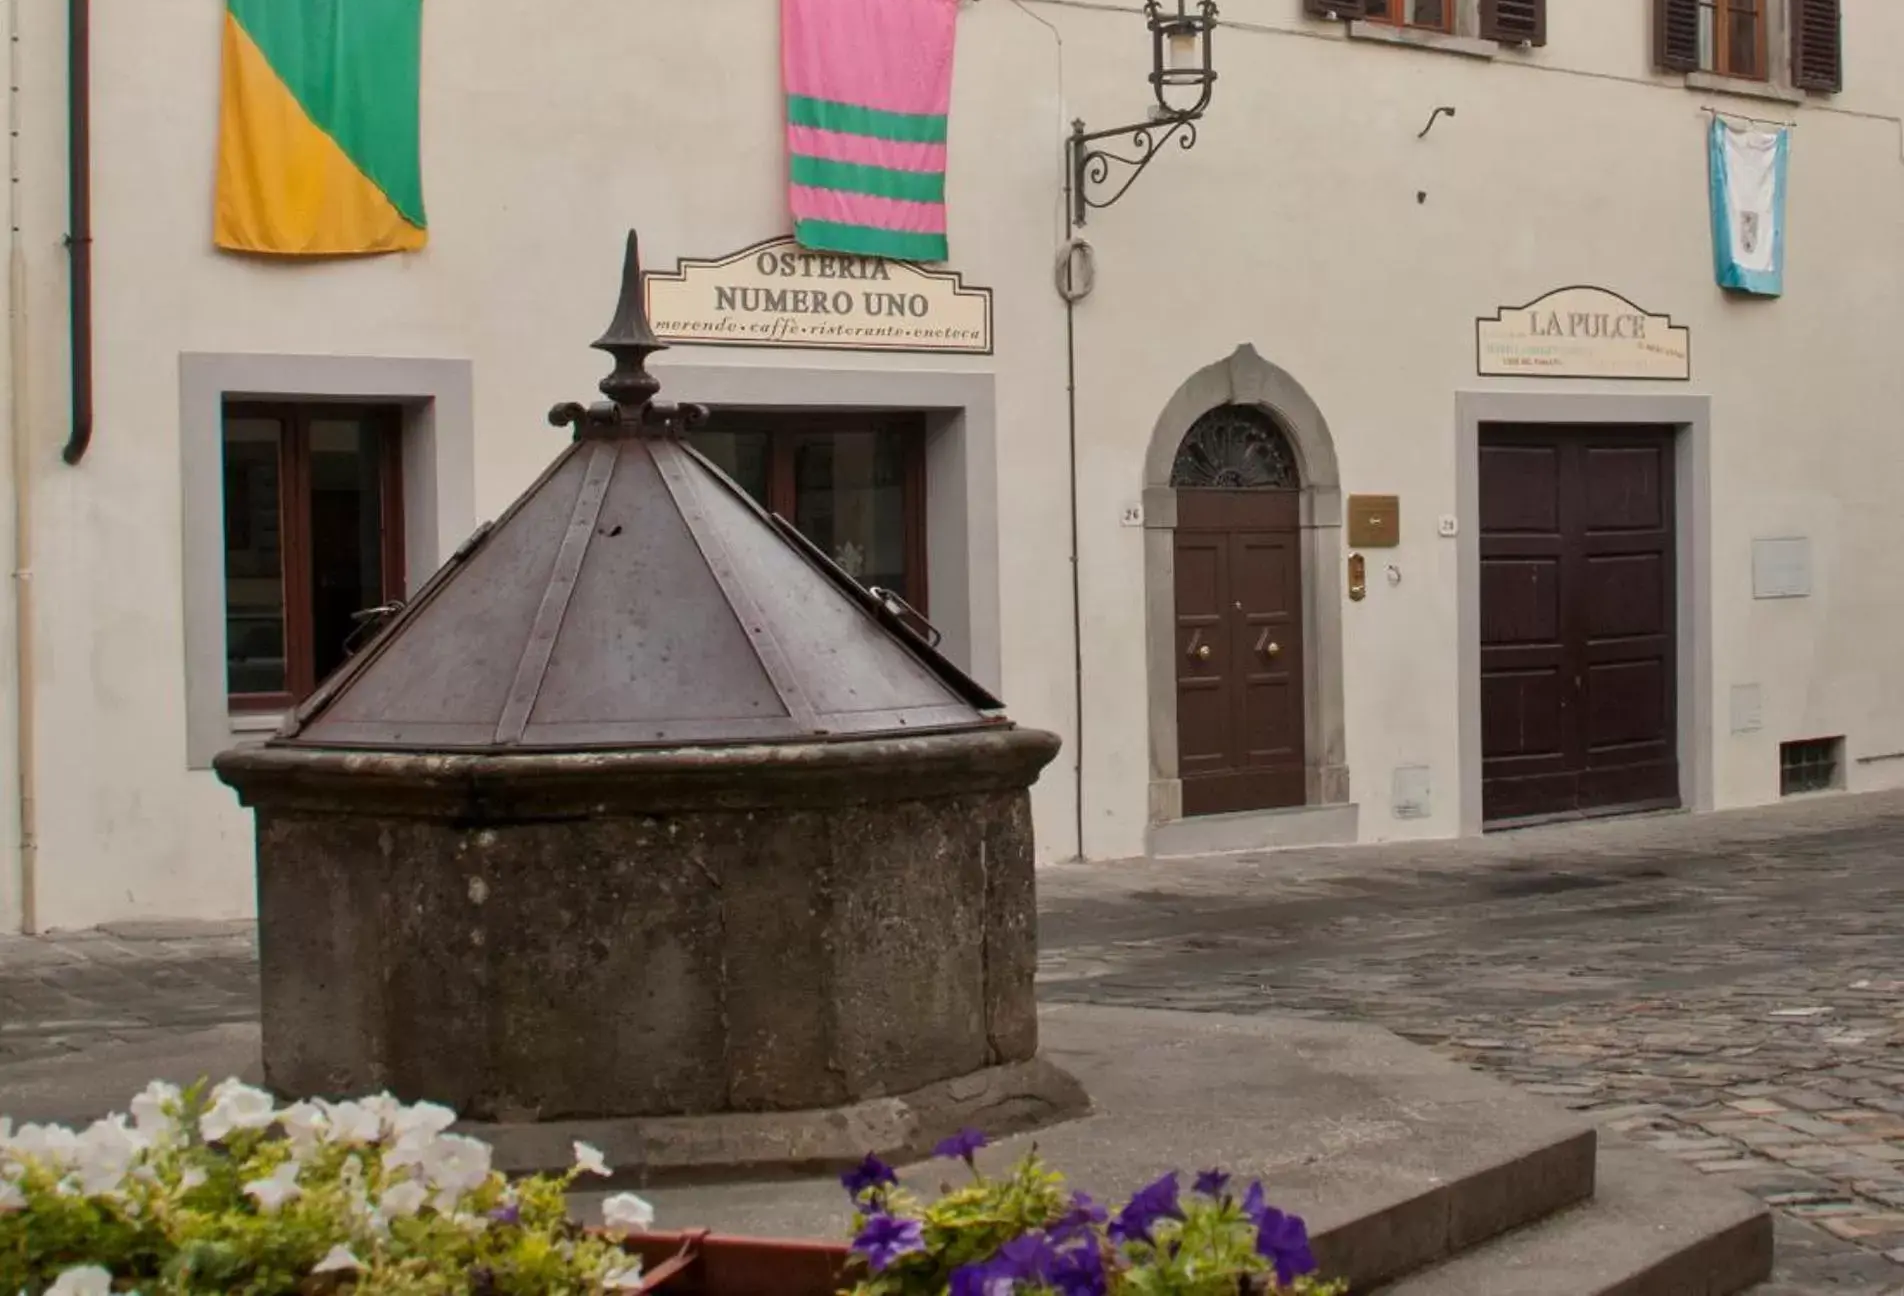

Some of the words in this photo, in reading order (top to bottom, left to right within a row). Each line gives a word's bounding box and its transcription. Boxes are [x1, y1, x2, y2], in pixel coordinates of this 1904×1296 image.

[756, 252, 891, 281] OSTERIA
[714, 286, 854, 315] NUMERO
[862, 291, 929, 317] UNO
[810, 322, 904, 337] ristorante
[914, 326, 980, 340] enoteca
[1529, 310, 1563, 337] LA
[1566, 312, 1646, 339] PULCE
[1124, 508, 1140, 520] 26
